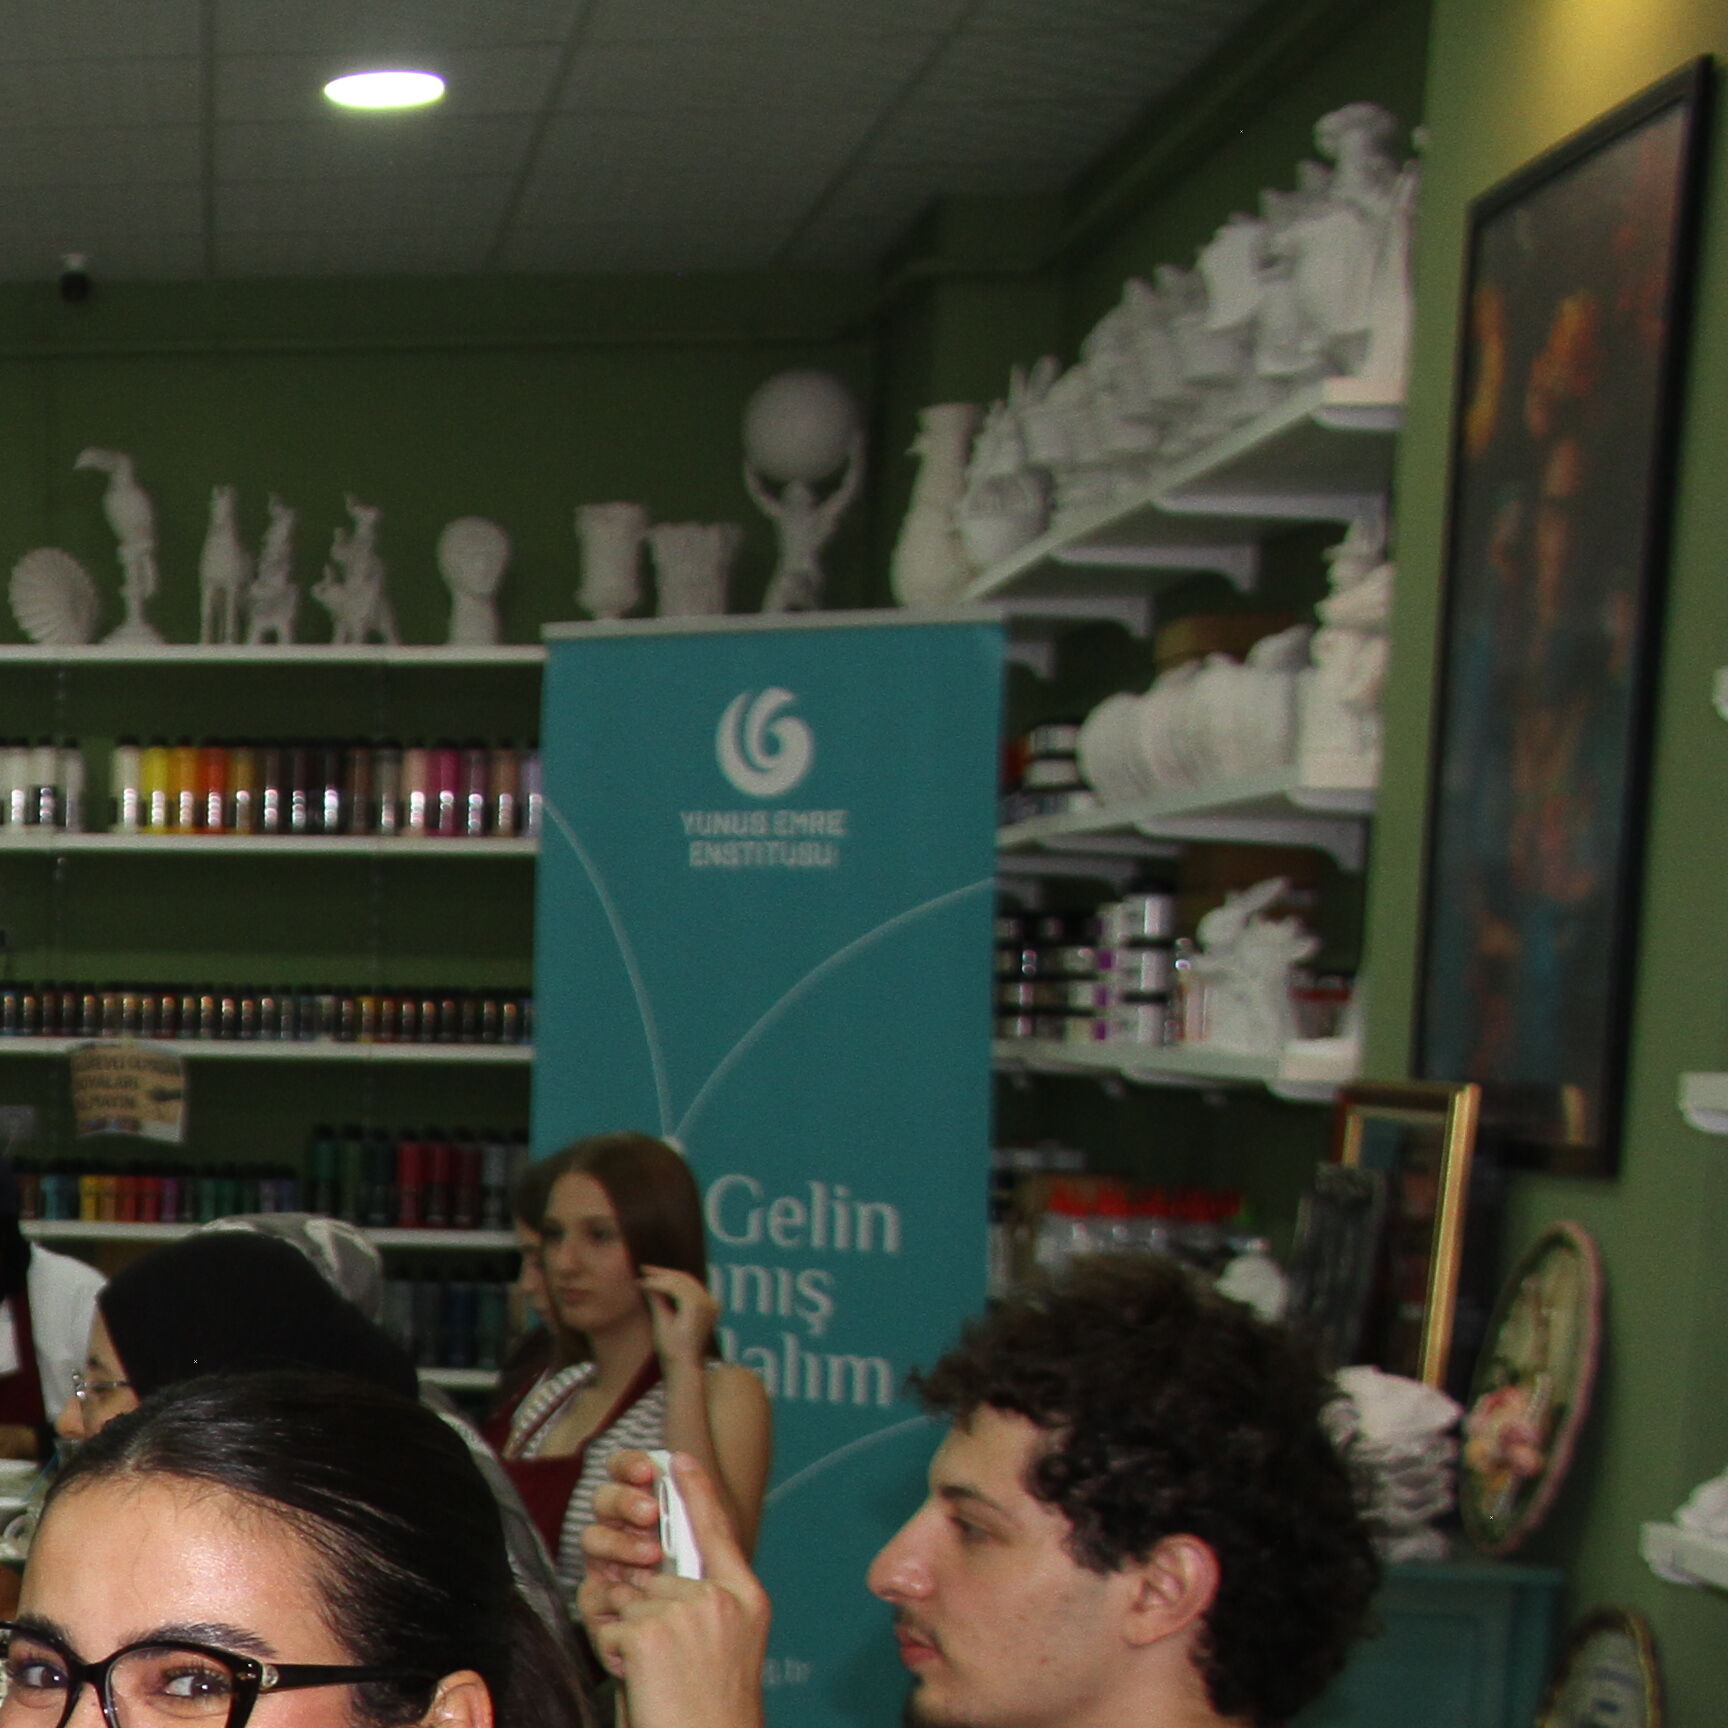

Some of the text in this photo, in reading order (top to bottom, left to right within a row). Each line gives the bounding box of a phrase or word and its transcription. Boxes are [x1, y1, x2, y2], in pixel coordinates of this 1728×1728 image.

[681, 809, 848, 835] YUNUS EMRE
[705, 1174, 901, 1253] Gelin
[708, 1262, 836, 1335] nış
